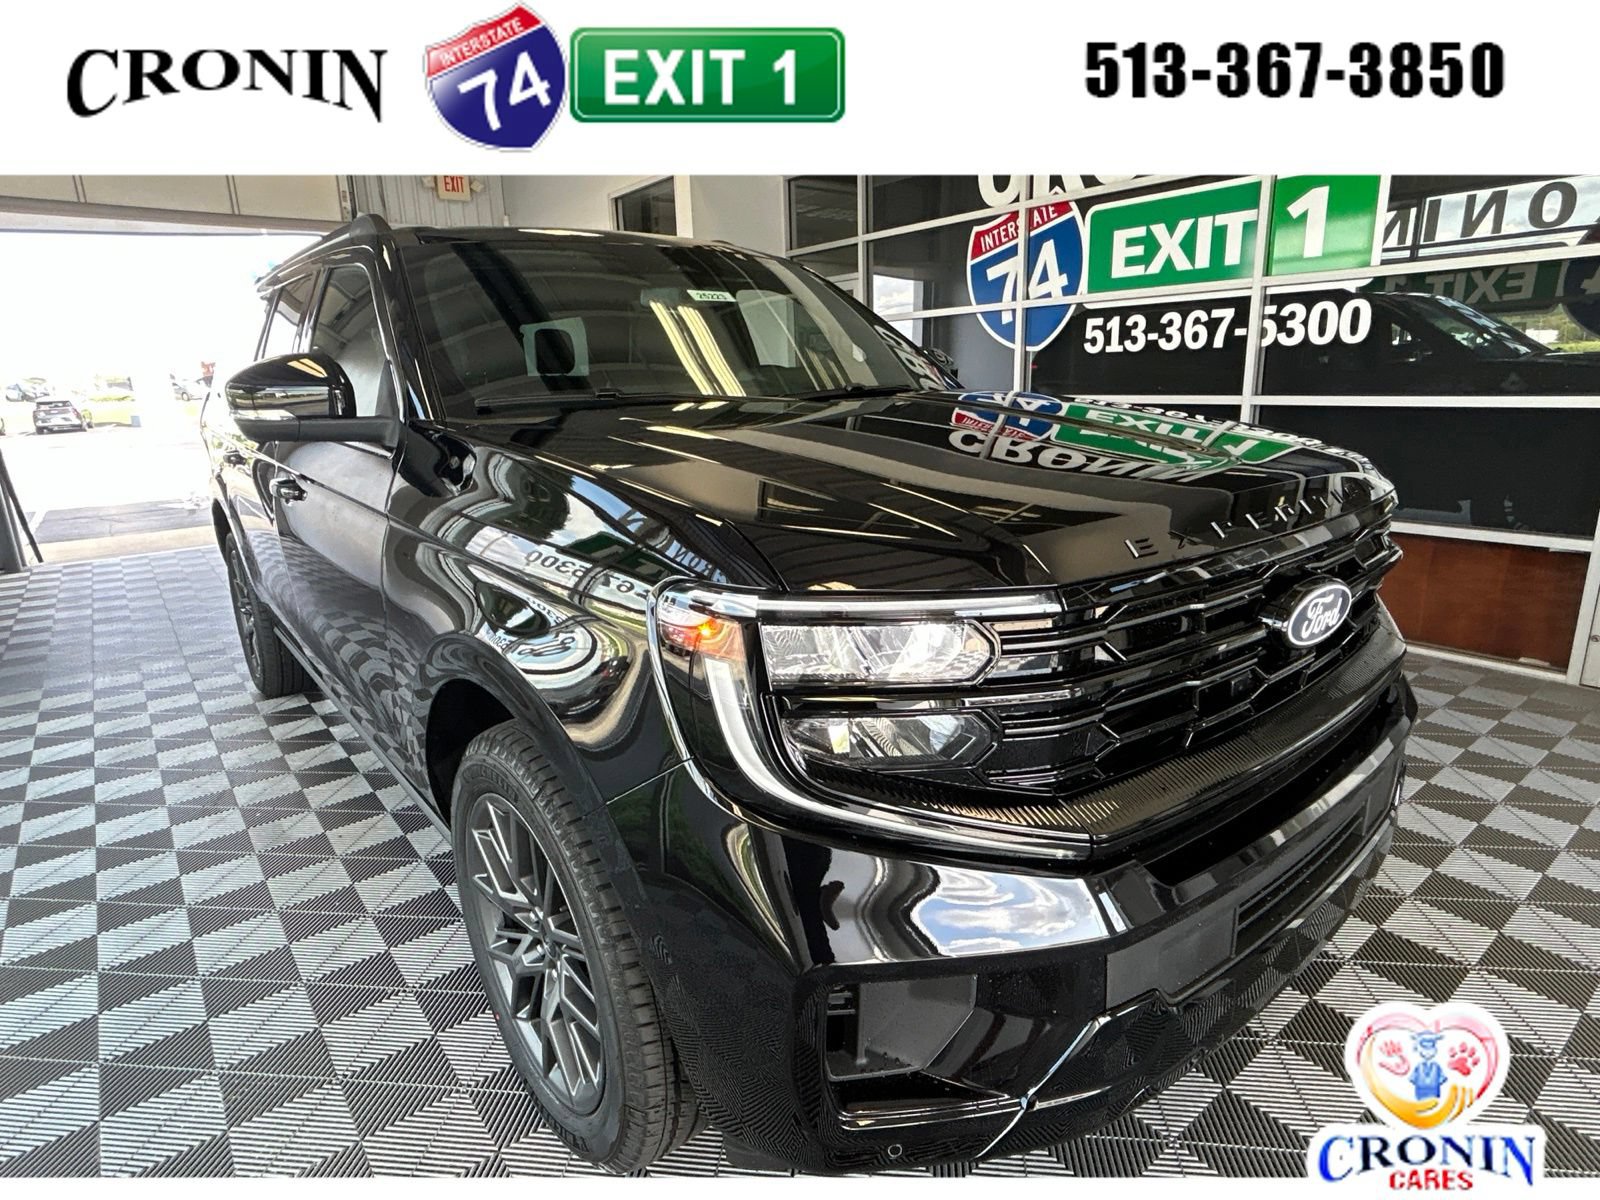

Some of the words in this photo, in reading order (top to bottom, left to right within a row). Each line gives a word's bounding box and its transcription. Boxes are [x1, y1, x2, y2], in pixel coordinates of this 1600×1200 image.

[443, 175, 464, 193] EXIT
[980, 205, 1059, 253] INTERATE
[1111, 208, 1258, 280] EXIT
[1286, 186, 1331, 259] 1
[986, 238, 1069, 325] 74
[1083, 298, 1373, 356] 513-367-5300
[1301, 594, 1343, 639] Ford
